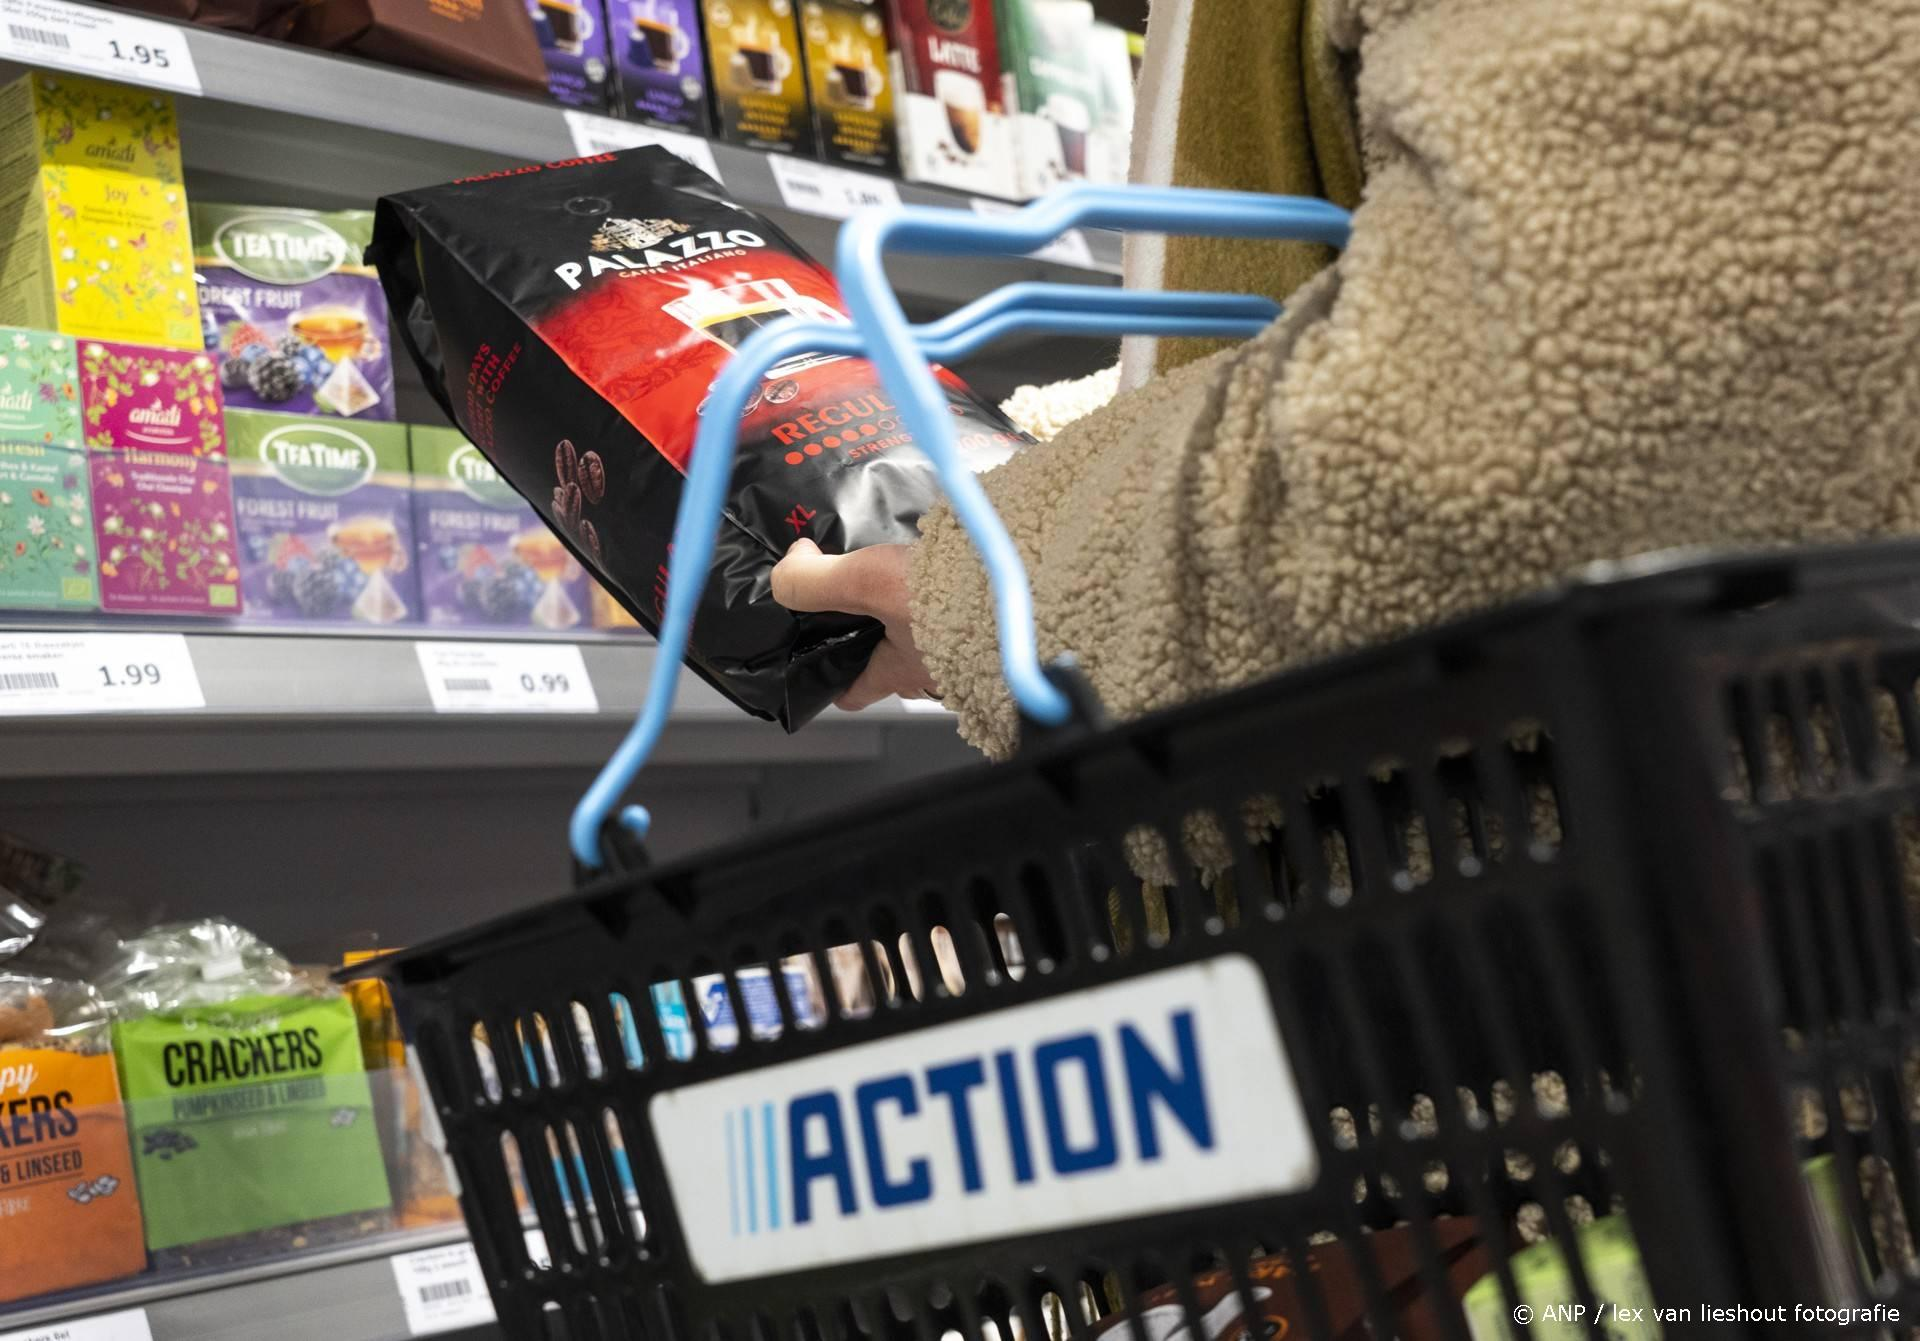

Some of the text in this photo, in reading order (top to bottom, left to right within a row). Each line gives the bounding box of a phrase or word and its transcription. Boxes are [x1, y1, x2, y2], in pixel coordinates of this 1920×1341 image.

[109, 40, 170, 68] 1.95
[927, 36, 982, 73] LATTE
[453, 152, 619, 184] PALAZZO COFFEE
[105, 184, 129, 203] Joy
[553, 228, 768, 291] PALAZZO
[671, 248, 748, 272] ITALIANO
[199, 286, 304, 309] OREST FRUIT
[467, 343, 491, 385] DAYS
[476, 354, 501, 396] WITH
[486, 341, 523, 404] COFFEE
[128, 404, 182, 428] amadi
[769, 393, 896, 446] REGUL
[849, 430, 913, 459] STRENG
[957, 432, 992, 450] 00
[123, 447, 198, 472] Harmony
[236, 498, 339, 520] FOREST FRUIT
[429, 510, 520, 531] FOREST FRUIT
[784, 503, 818, 535] XL
[98, 662, 162, 687] 1.99
[520, 673, 571, 694] 0.99
[163, 1026, 323, 1087] CRACKERS
[788, 1008, 1217, 1225] ACTION
[15, 1148, 83, 1182] LINSEED
